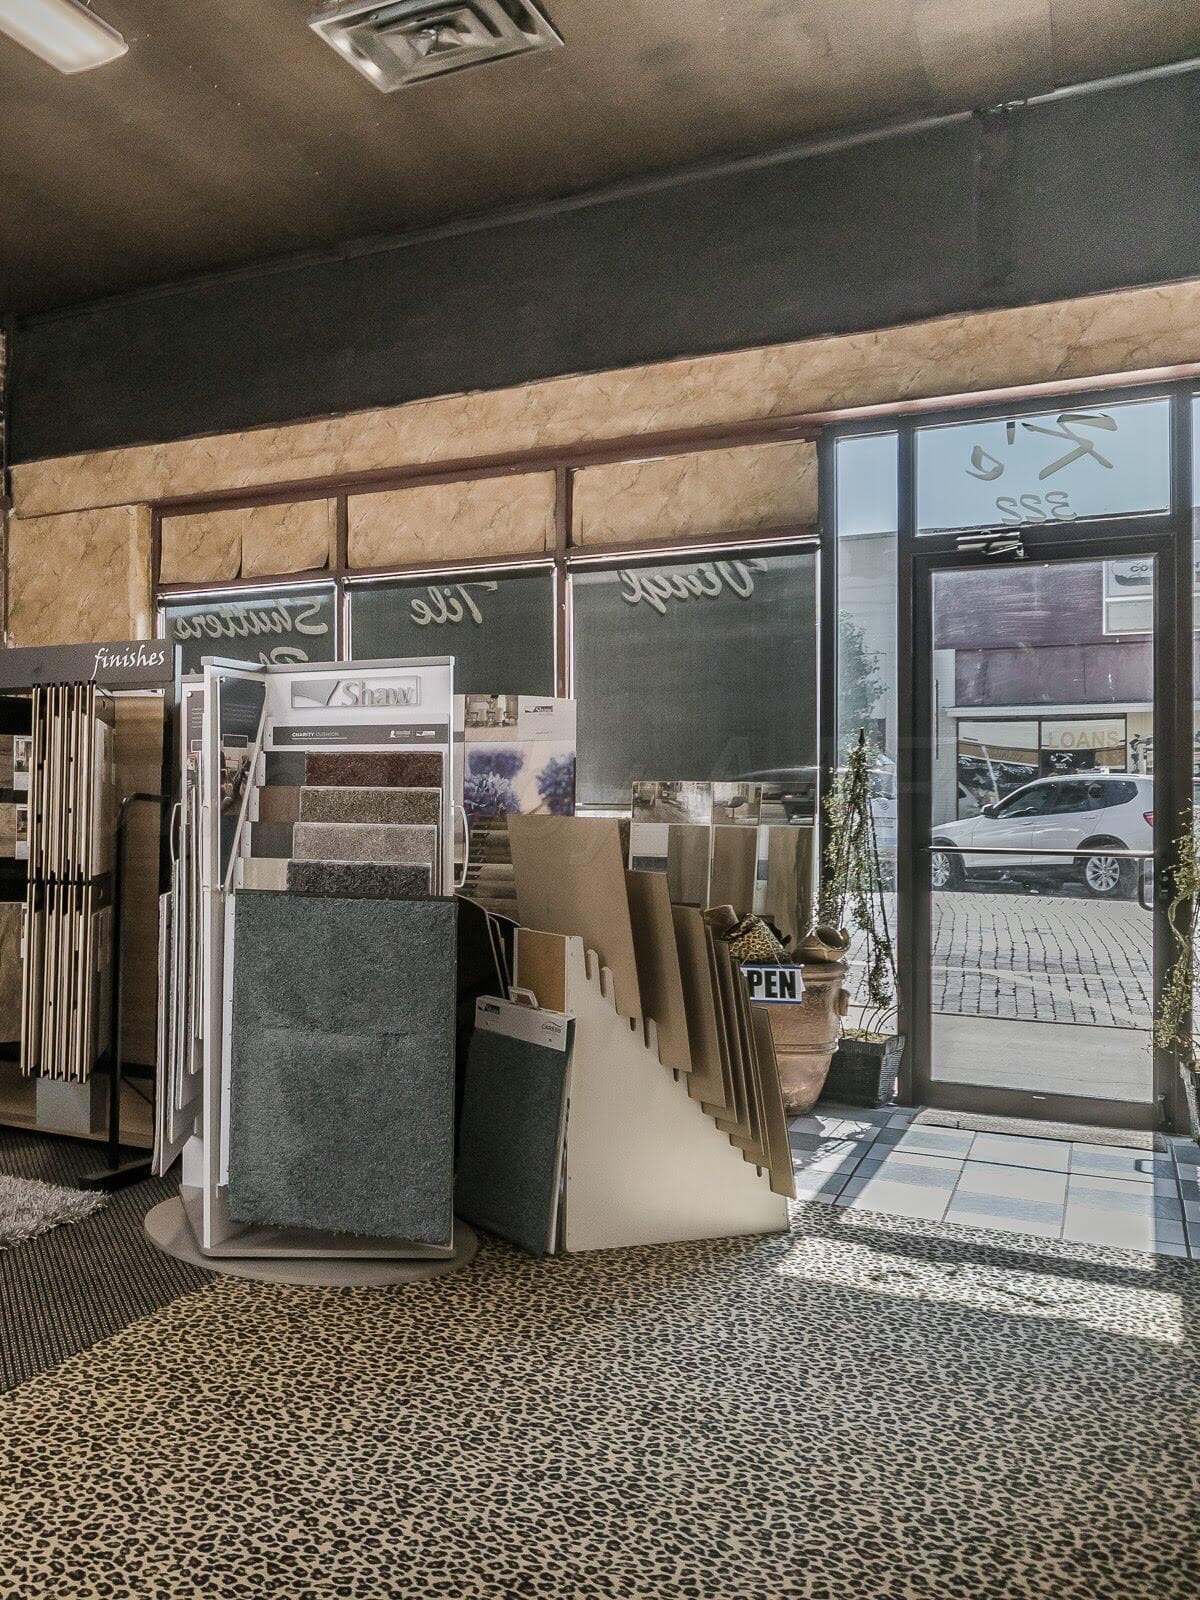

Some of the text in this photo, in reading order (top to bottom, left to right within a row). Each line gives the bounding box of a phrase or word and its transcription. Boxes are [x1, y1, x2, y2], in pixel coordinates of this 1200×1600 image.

[90, 644, 165, 681] finishes
[341, 680, 415, 706] Shaw
[1049, 730, 1119, 749] LOANS
[746, 969, 797, 999] PEN
[542, 1023, 562, 1034] CARESS
